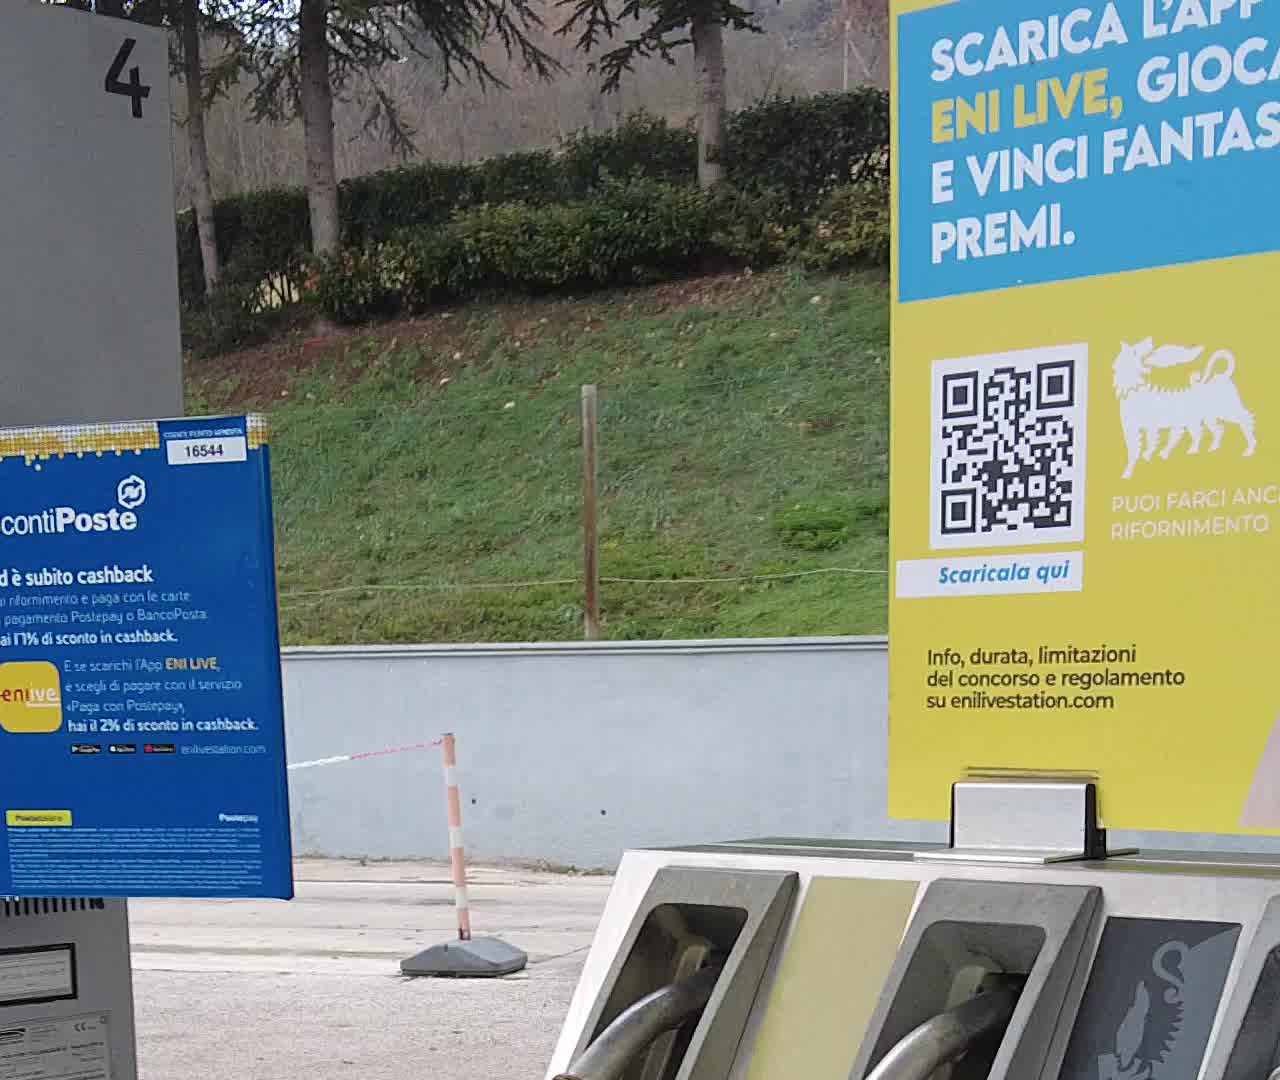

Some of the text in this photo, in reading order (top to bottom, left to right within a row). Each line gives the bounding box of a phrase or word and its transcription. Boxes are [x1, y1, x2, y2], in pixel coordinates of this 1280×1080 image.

[930, 3, 1128, 82] SCARICA
[103, 37, 152, 118] 4
[931, 88, 1000, 144] ENI
[1013, 68, 1123, 128] LIVE,
[931, 160, 955, 203] E
[966, 136, 1088, 198] VINCI
[931, 203, 1075, 265] PREMI.
[185, 444, 225, 457] 16544
[1112, 495, 1161, 513] PUOI
[1166, 489, 1226, 511] FARCI
[1111, 514, 1270, 540] RIFORNIMENTO
[11, 567, 22, 587] è
[25, 567, 74, 587] subito
[77, 564, 154, 585] cashback
[938, 560, 1070, 585] Scaricala qui
[9, 592, 79, 607] rifornimento
[81, 594, 89, 604] e
[91, 594, 121, 607] paga
[123, 593, 145, 603] con
[147, 590, 159, 602] le
[160, 591, 191, 602] carte
[4, 611, 69, 626] pagamento
[71, 610, 124, 625] Postepay
[126, 612, 134, 622] o
[41, 631, 54, 645] di
[55, 631, 98, 645] sconto
[100, 630, 113, 644] in
[64, 659, 71, 672] E
[74, 663, 88, 672] se
[90, 659, 133, 671] scarichi
[165, 657, 187, 671] ENI
[189, 656, 221, 672] LIVE,
[927, 644, 1137, 668] Info, durata, limitazioni
[65, 682, 72, 692] e
[75, 680, 107, 694] scegli
[109, 679, 121, 691] di
[123, 680, 161, 694] pagare
[164, 681, 186, 691] con
[198, 679, 243, 690] servizio
[926, 667, 1186, 689] del concorso e regolamento
[103, 701, 124, 712] con
[926, 691, 1115, 709] su enilivestation.com
[68, 717, 259, 733] hai il 2% di sconto in cashback.
